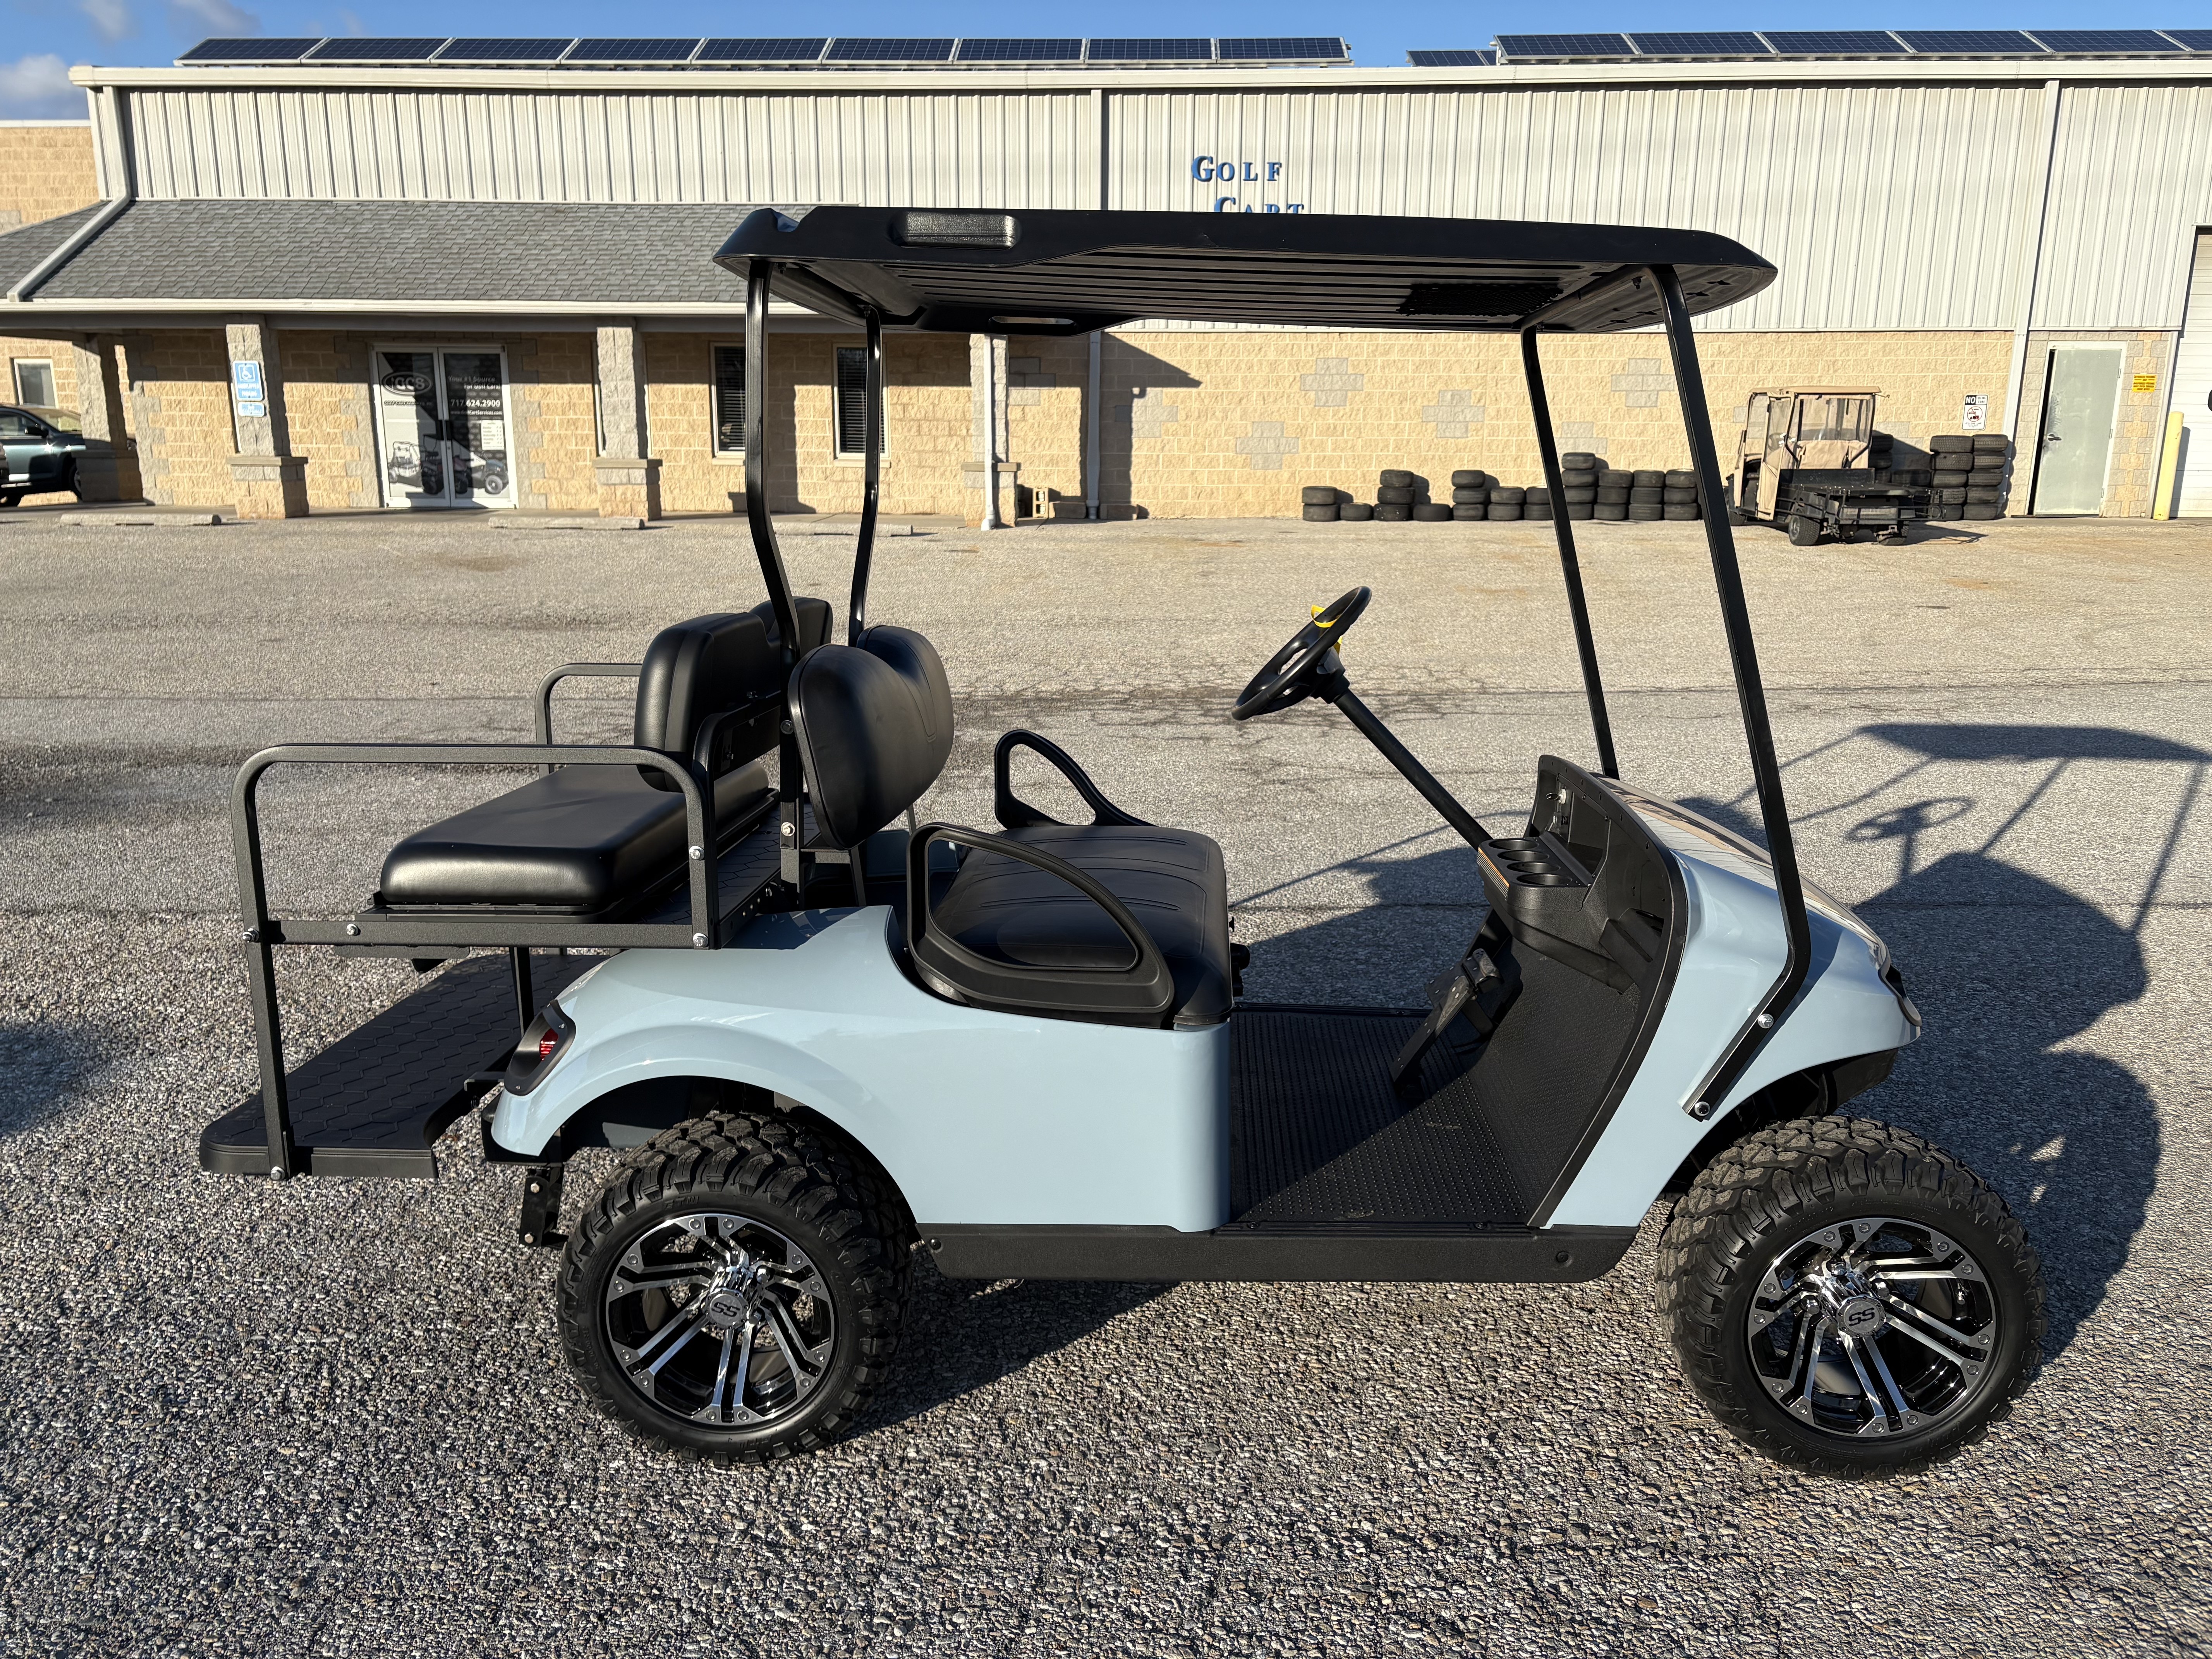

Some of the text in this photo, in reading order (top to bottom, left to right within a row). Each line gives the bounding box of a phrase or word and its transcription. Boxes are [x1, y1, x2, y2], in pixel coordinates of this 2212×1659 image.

[1191, 156, 1282, 182] GOLF
[450, 399, 500, 407] 717.624.2900
[711, 1302, 740, 1317] SS
[1849, 1307, 1875, 1326] SS
